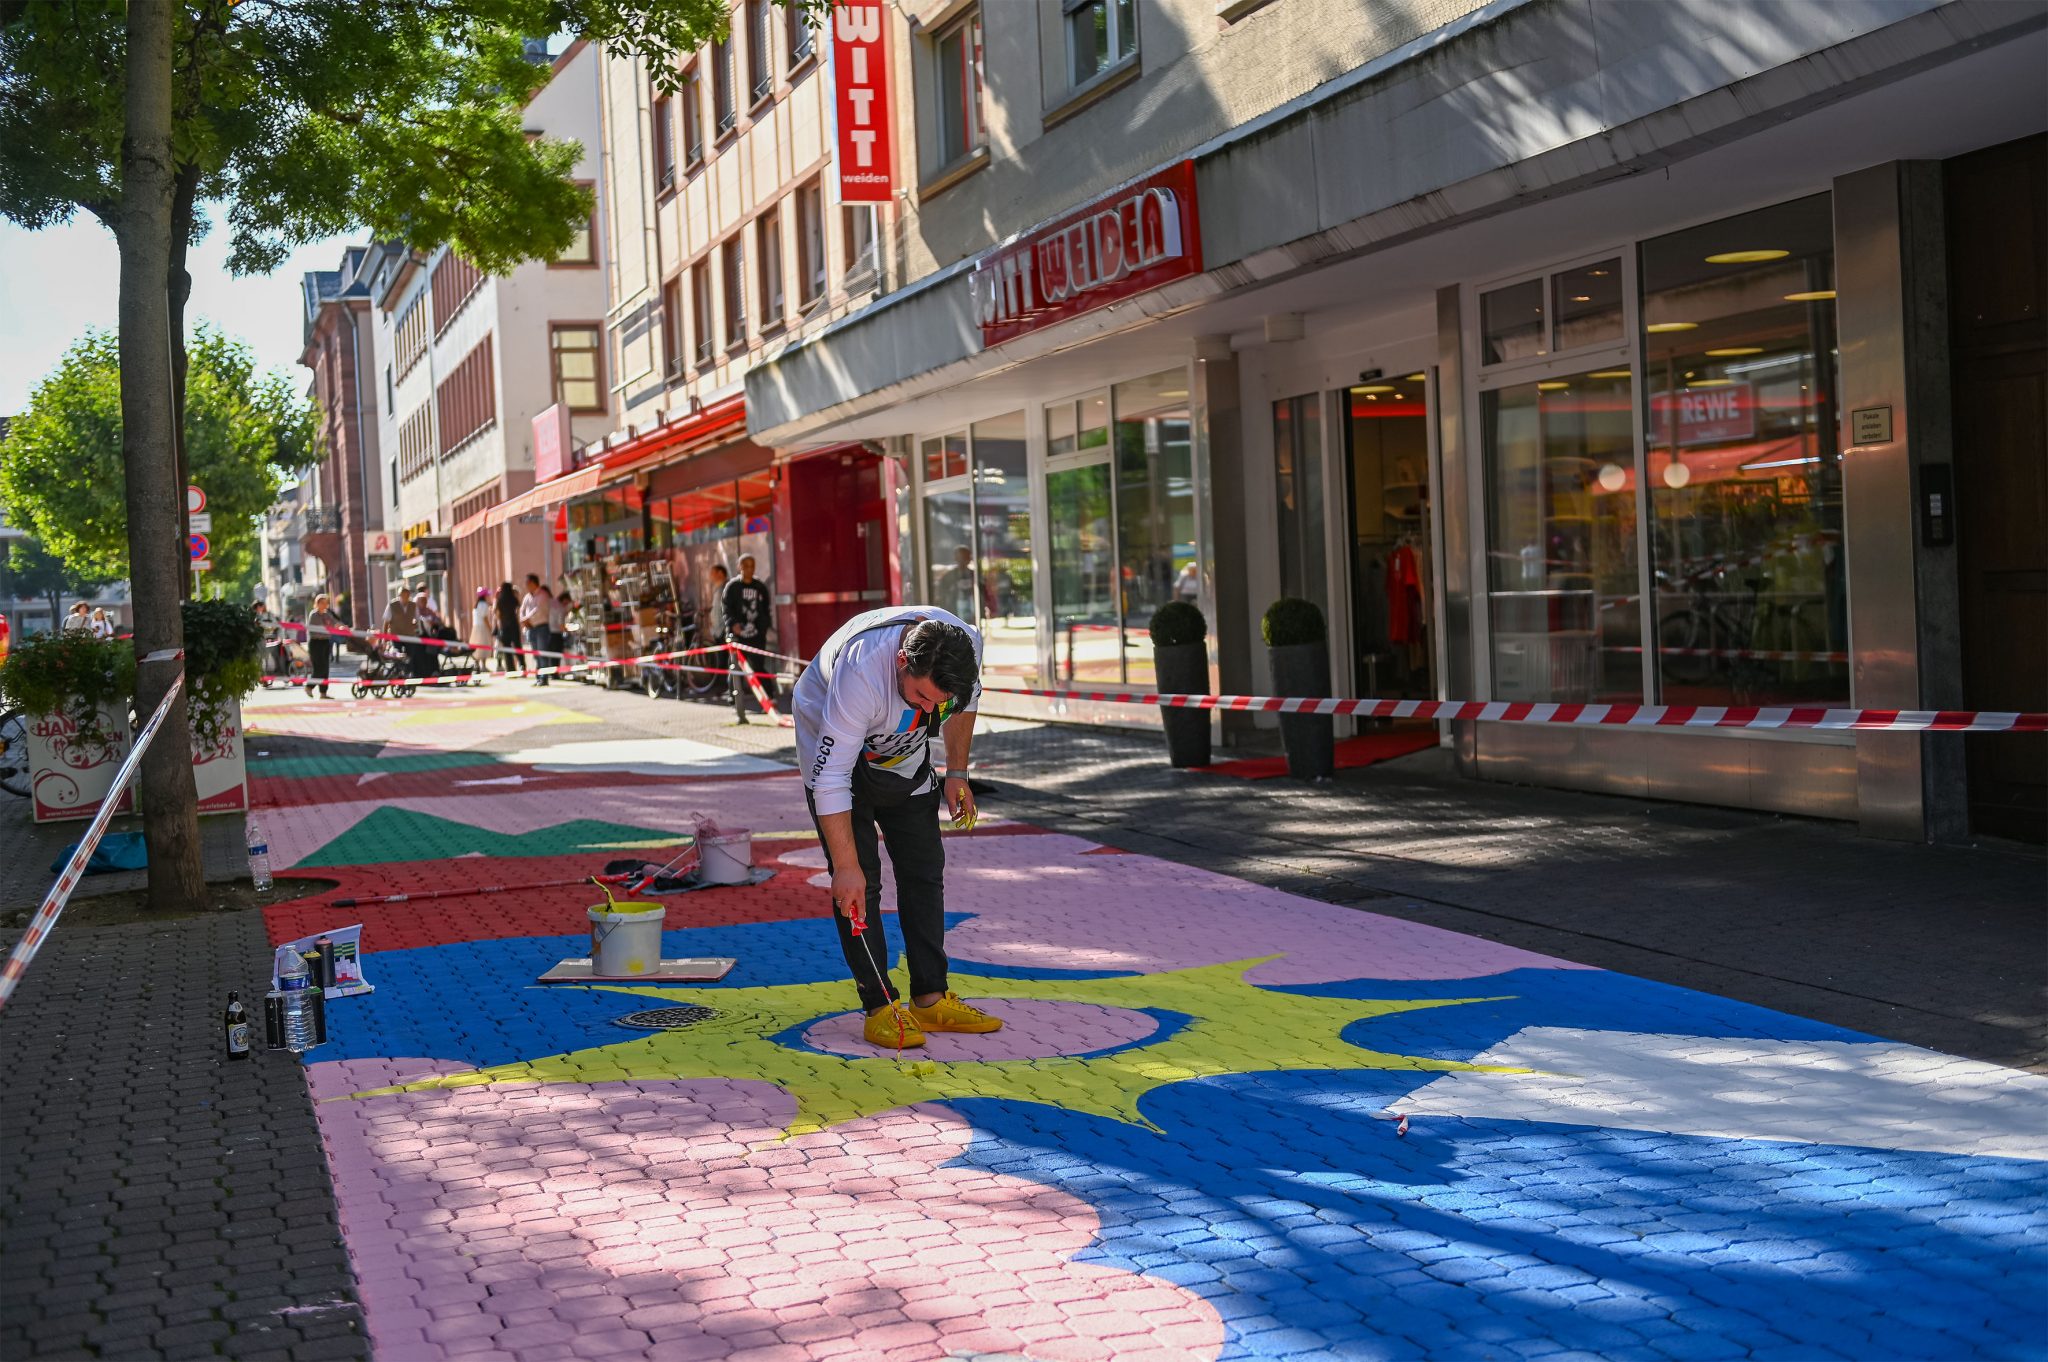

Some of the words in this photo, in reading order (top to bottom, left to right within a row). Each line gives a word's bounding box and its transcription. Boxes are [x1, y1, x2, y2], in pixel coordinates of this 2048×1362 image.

[835, 5, 882, 167] WITT
[842, 173, 889, 183] weiden
[967, 250, 1034, 328] WITT
[1038, 187, 1183, 304] WEIDEN
[1680, 390, 1740, 424] REWE
